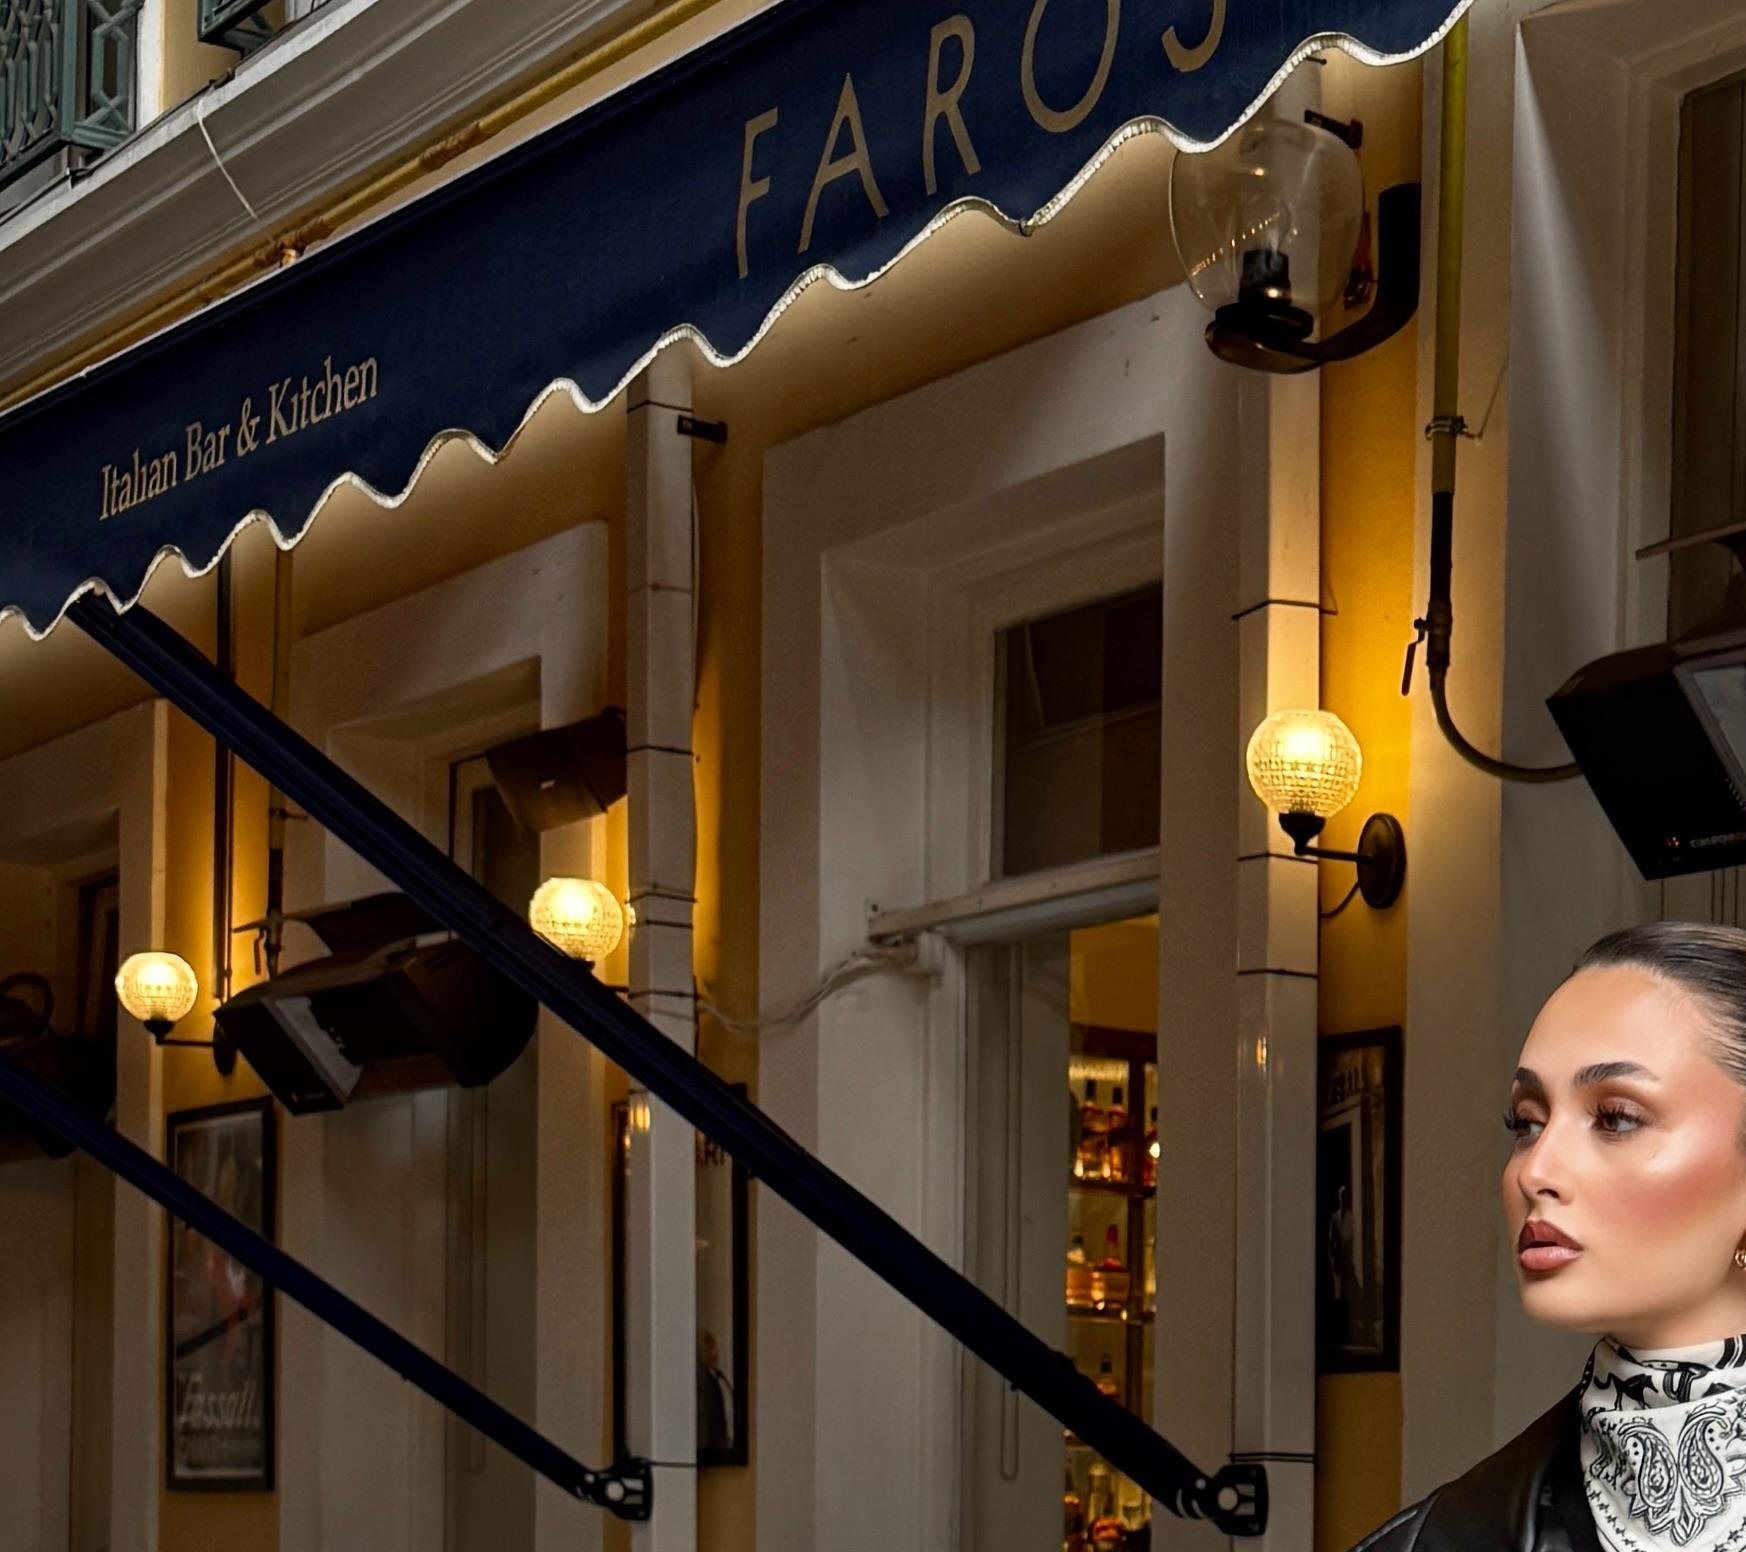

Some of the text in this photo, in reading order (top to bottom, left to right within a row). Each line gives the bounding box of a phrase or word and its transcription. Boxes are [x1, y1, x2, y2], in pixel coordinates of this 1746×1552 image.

[99, 354, 378, 521] Italian Bar & Kitchen
